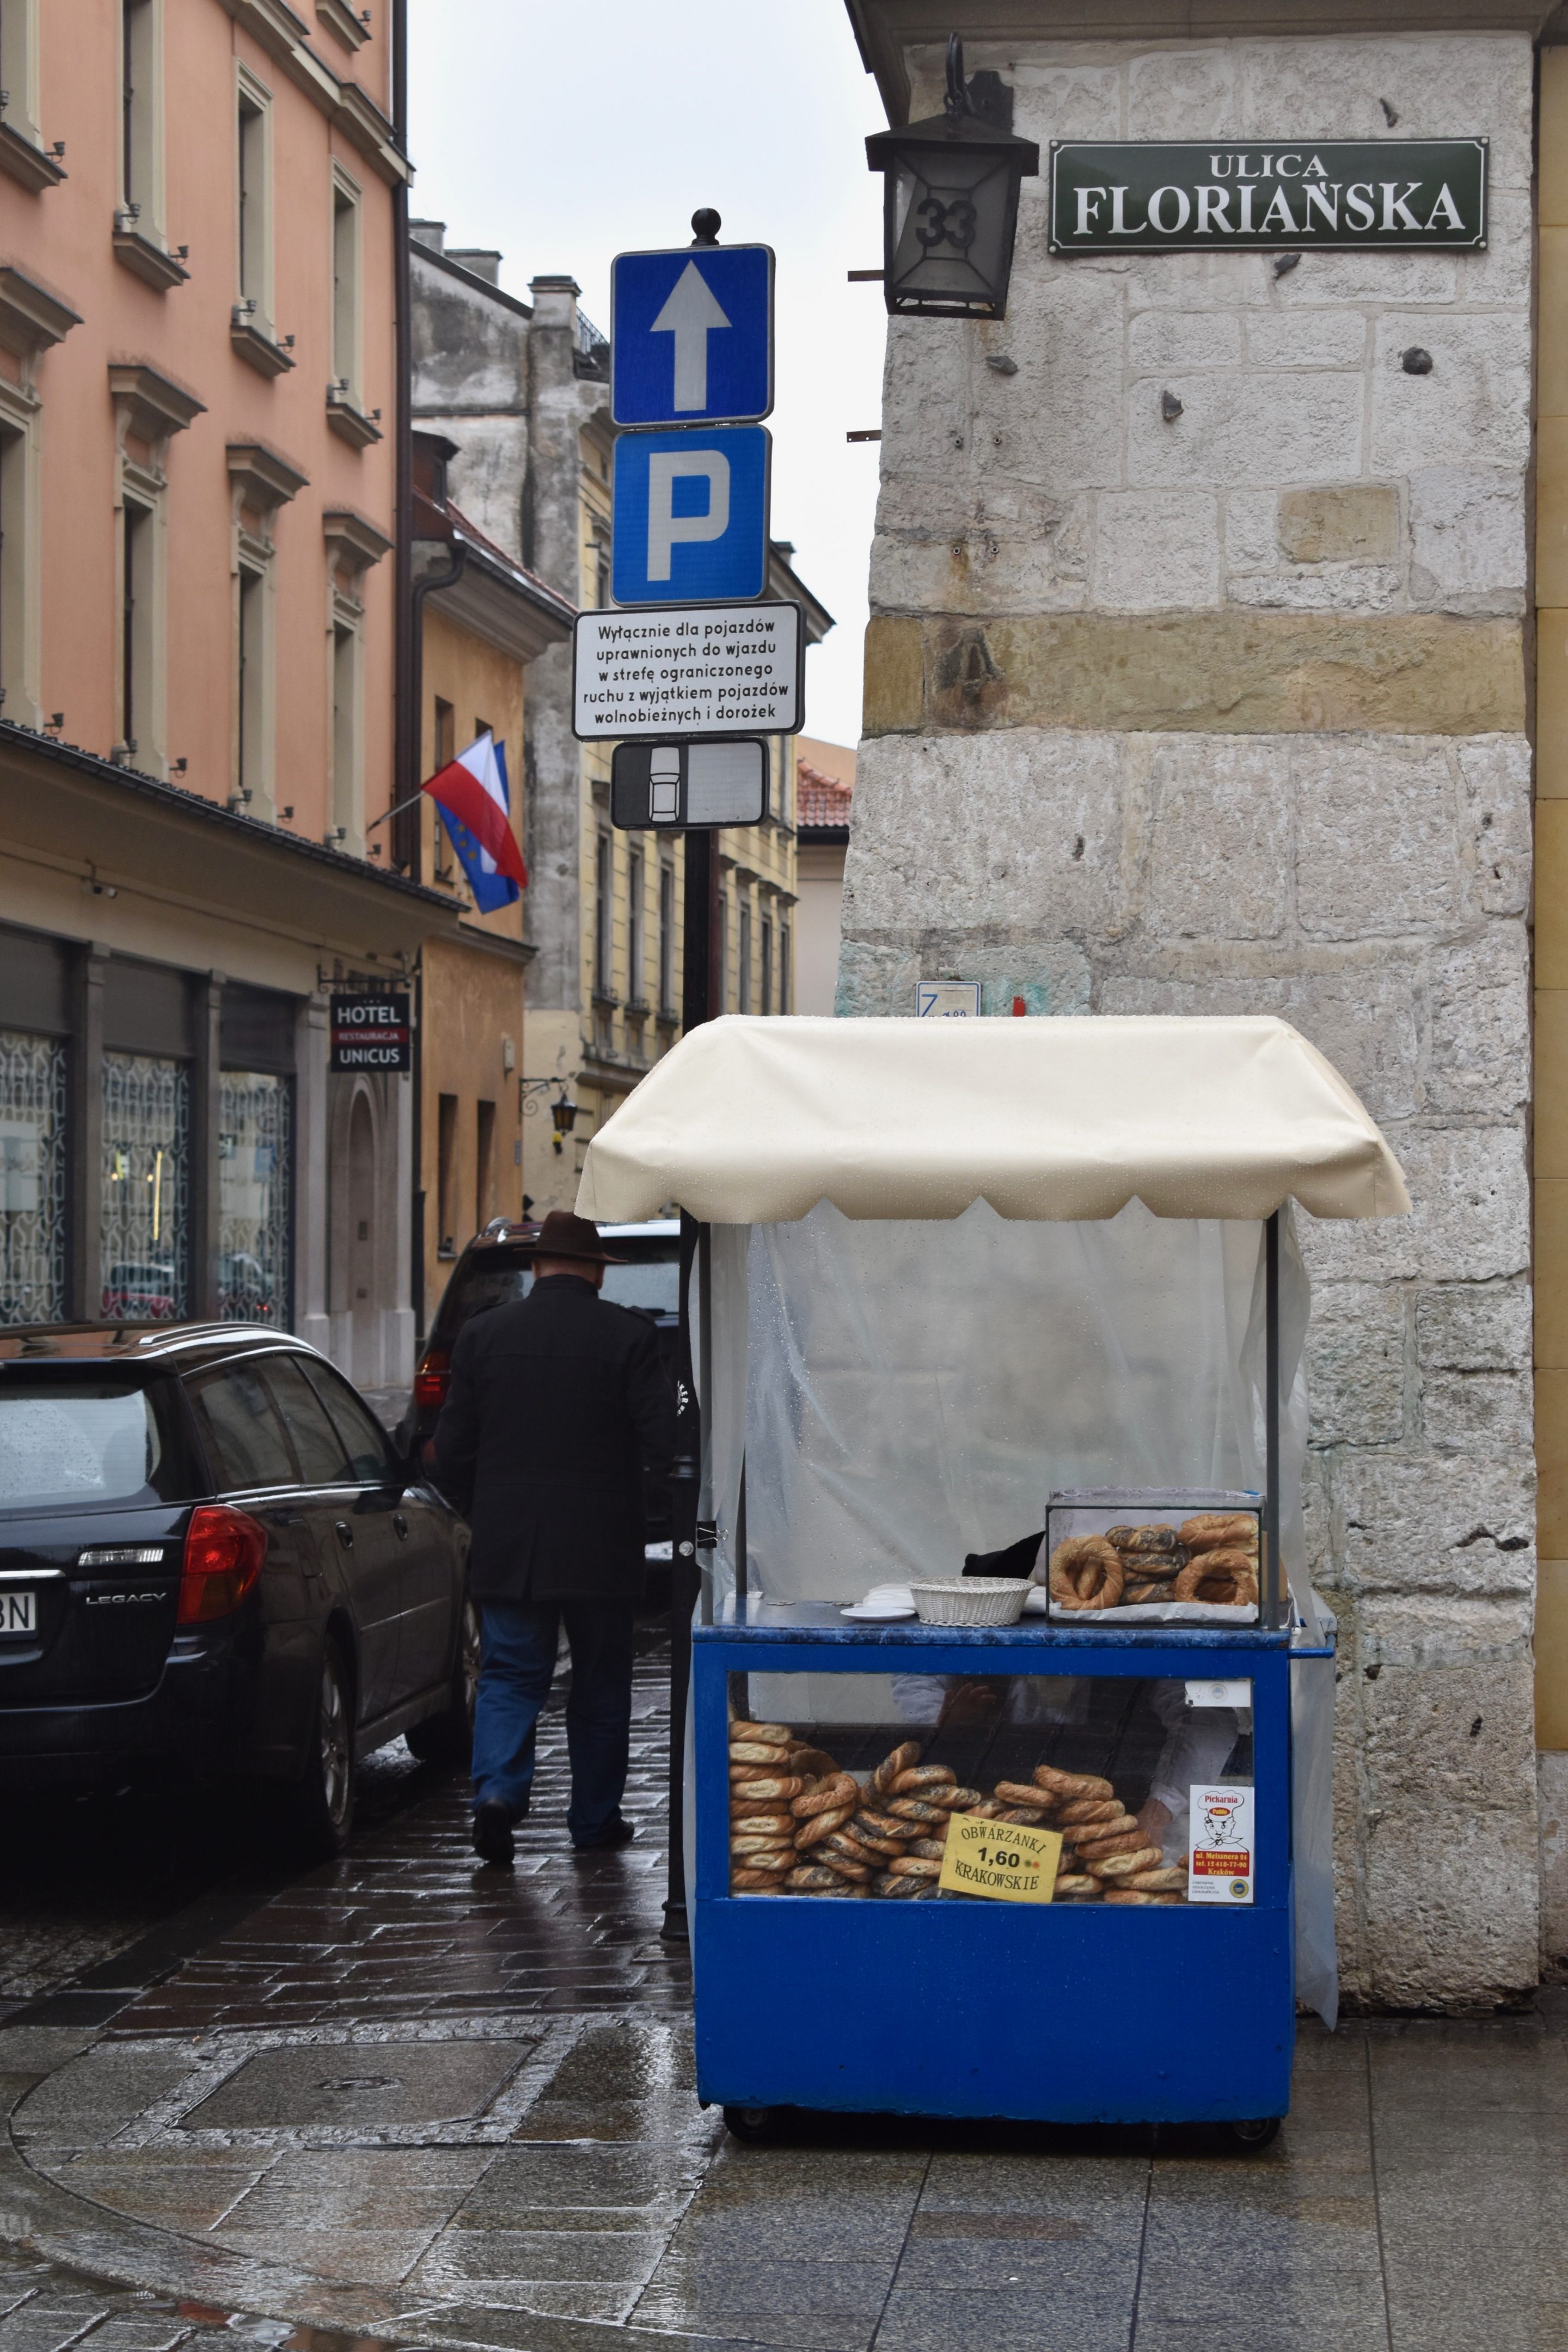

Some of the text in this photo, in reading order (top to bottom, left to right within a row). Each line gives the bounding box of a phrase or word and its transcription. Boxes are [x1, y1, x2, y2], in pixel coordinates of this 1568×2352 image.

[1209, 155, 1328, 177] ULICA
[1073, 182, 1466, 235] FLORIAŃSKA
[915, 198, 977, 249] 33
[647, 450, 730, 581] P
[598, 618, 775, 644] Wyłącznie dla pojazdów
[597, 640, 776, 664] uprawnionych do wjazdu
[599, 664, 773, 683] w strefę ograniczonego
[584, 682, 788, 705] ruchu z wyjątkiem pojazdów
[595, 703, 775, 725] wolnobieżnych i dorożek
[338, 1006, 401, 1024] HOTEL
[339, 1031, 399, 1040] RESTAURACJA
[340, 1048, 400, 1064] UNICUS
[86, 1592, 167, 1605] LEGACY
[961, 1827, 1046, 1854] OBWARZANKI
[978, 1847, 1020, 1867] 1,60
[955, 1858, 1039, 1890] KRAKOWSKIE
